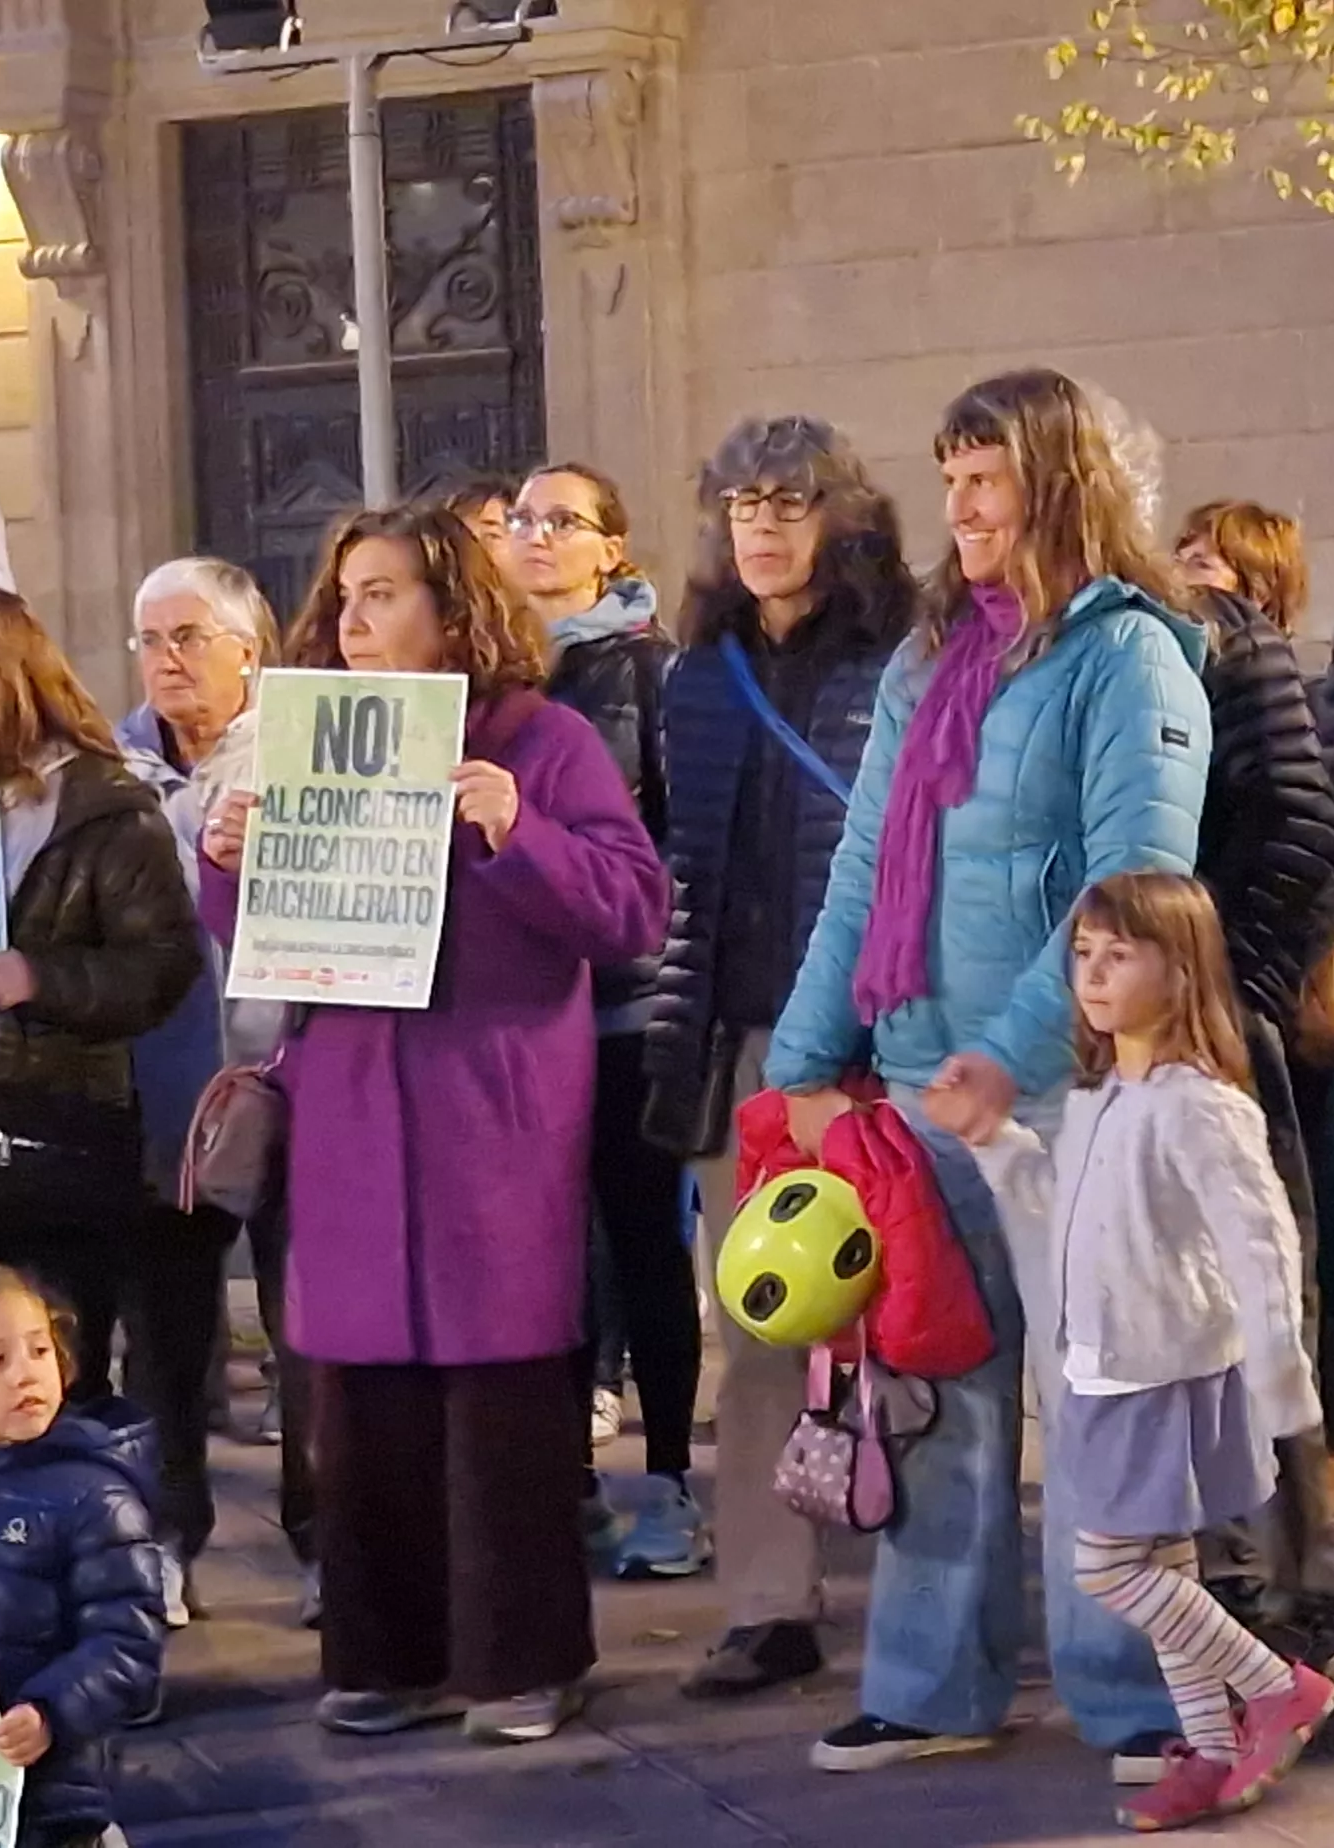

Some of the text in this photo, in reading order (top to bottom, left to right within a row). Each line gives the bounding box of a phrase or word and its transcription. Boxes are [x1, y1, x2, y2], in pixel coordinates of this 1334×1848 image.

[312, 695, 405, 777] NO!
[261, 784, 443, 829] AL CONCIERTO
[257, 831, 436, 877] EDUCATIVO EN
[246, 877, 434, 926] BACHILLERATO
